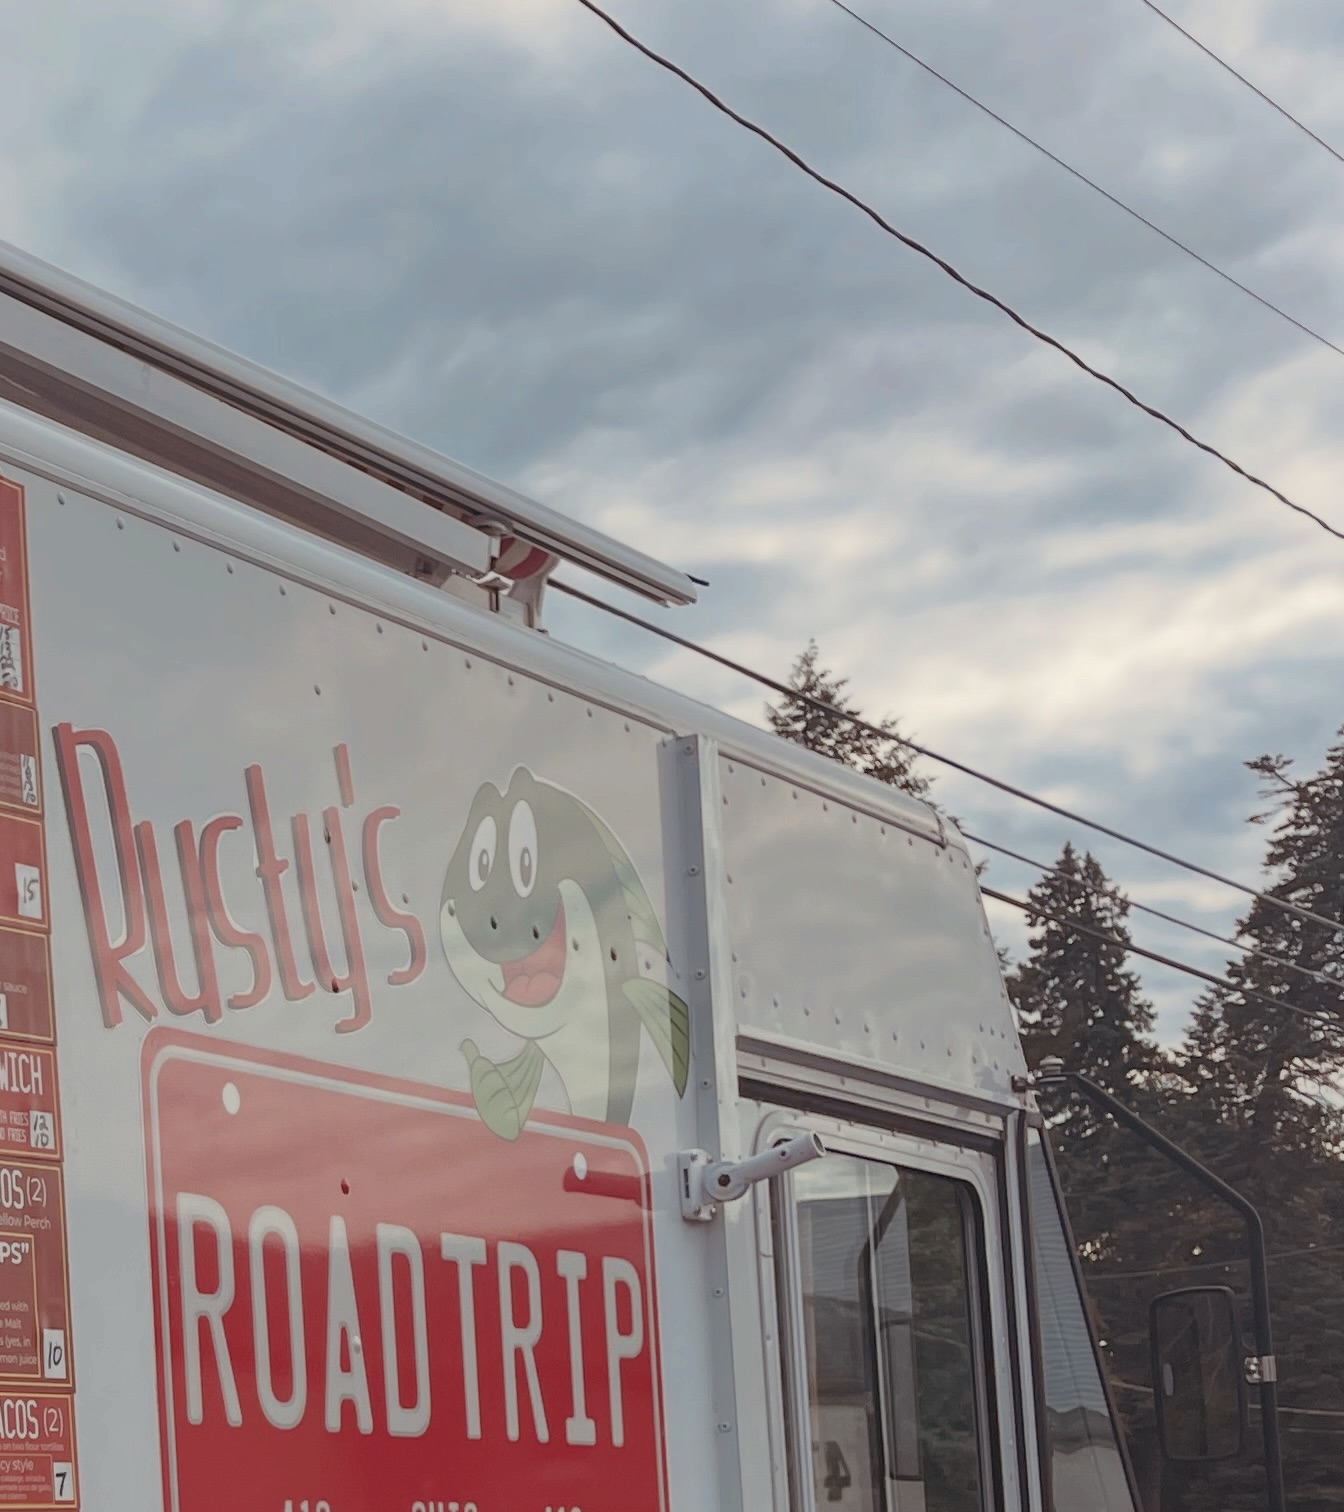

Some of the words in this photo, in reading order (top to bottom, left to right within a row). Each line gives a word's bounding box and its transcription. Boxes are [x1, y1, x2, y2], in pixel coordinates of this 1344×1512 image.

[22, 876, 40, 905] 15
[51, 720, 427, 1034] Rusty's
[46, 1339, 64, 1371] 10
[55, 1470, 68, 1497] 7
